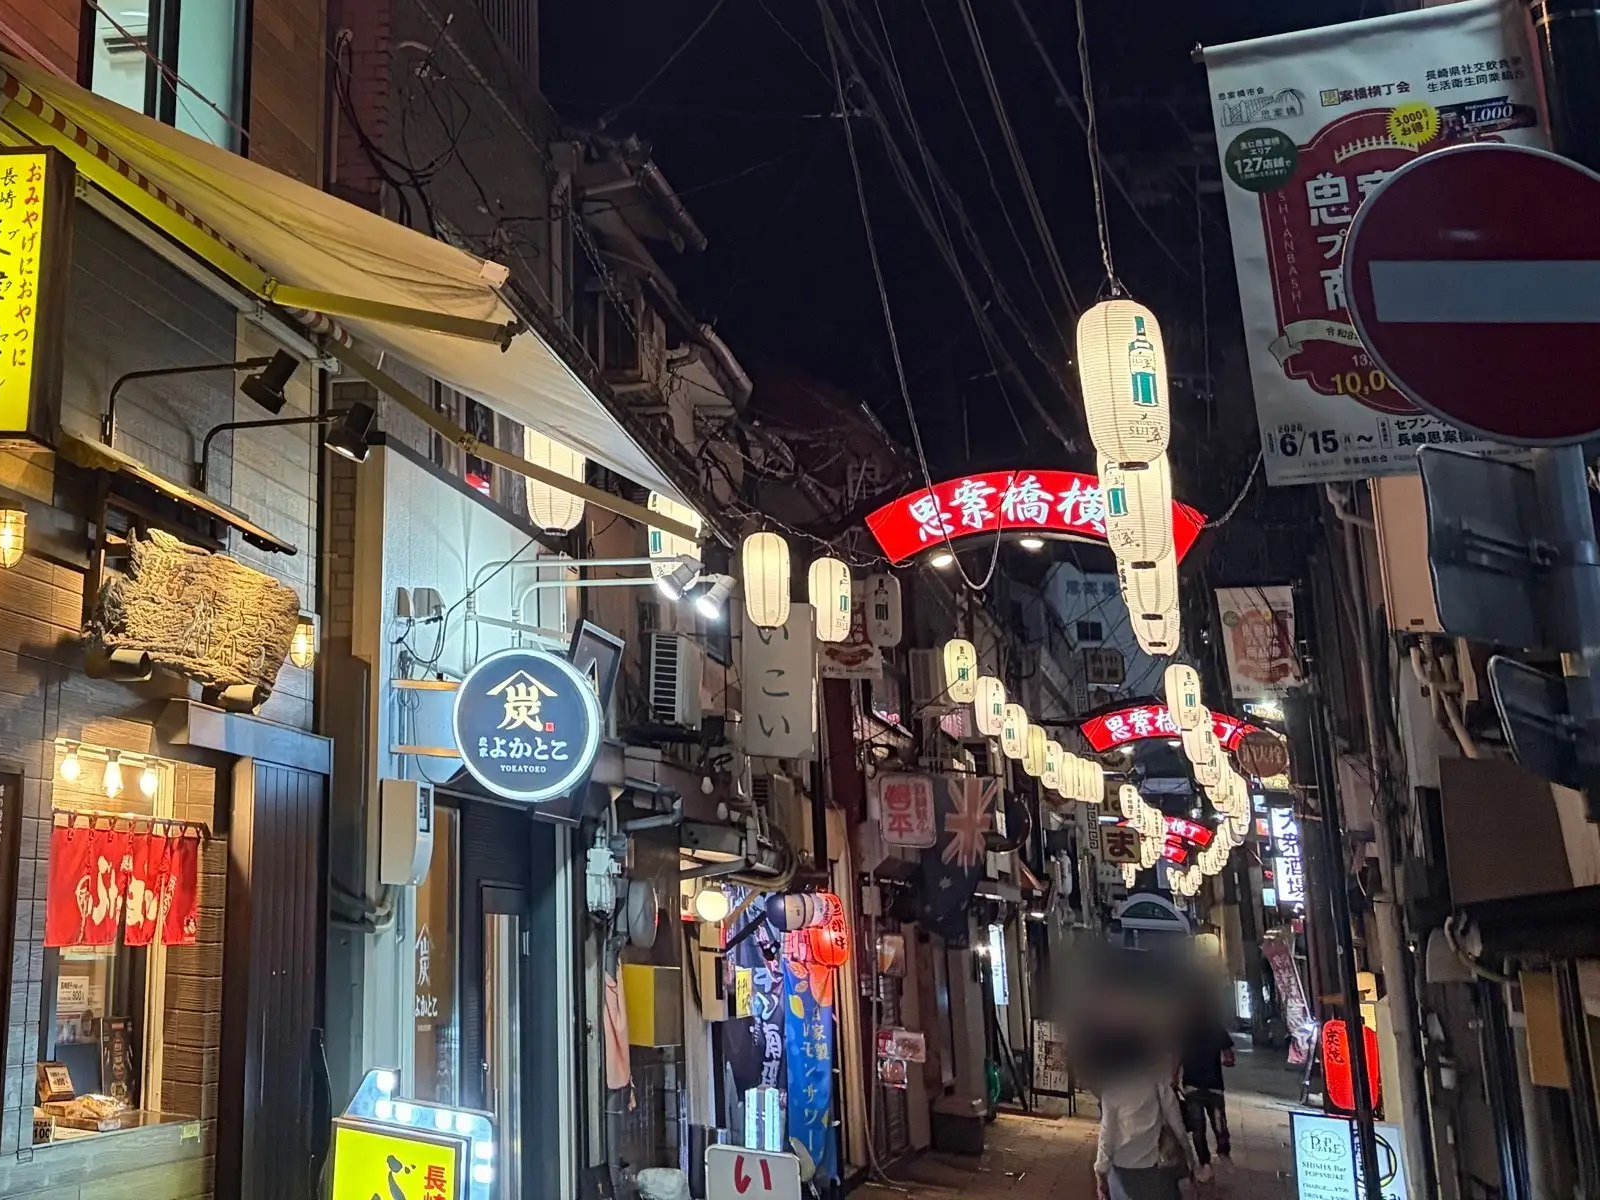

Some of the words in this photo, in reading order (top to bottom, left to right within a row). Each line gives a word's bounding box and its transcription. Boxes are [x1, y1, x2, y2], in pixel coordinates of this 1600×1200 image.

[11, 162, 45, 367] おみやげにおやつに
[1279, 429, 1339, 457] 6/15
[909, 476, 1108, 543] 思案橋横
[497, 682, 544, 732] 炭
[1105, 708, 1237, 742] 思案橋丁
[489, 736, 569, 761] よかとこ
[500, 764, 547, 774] YOKATOKO
[800, 1022, 818, 1152] レモンサワー
[735, 1154, 773, 1195] い
